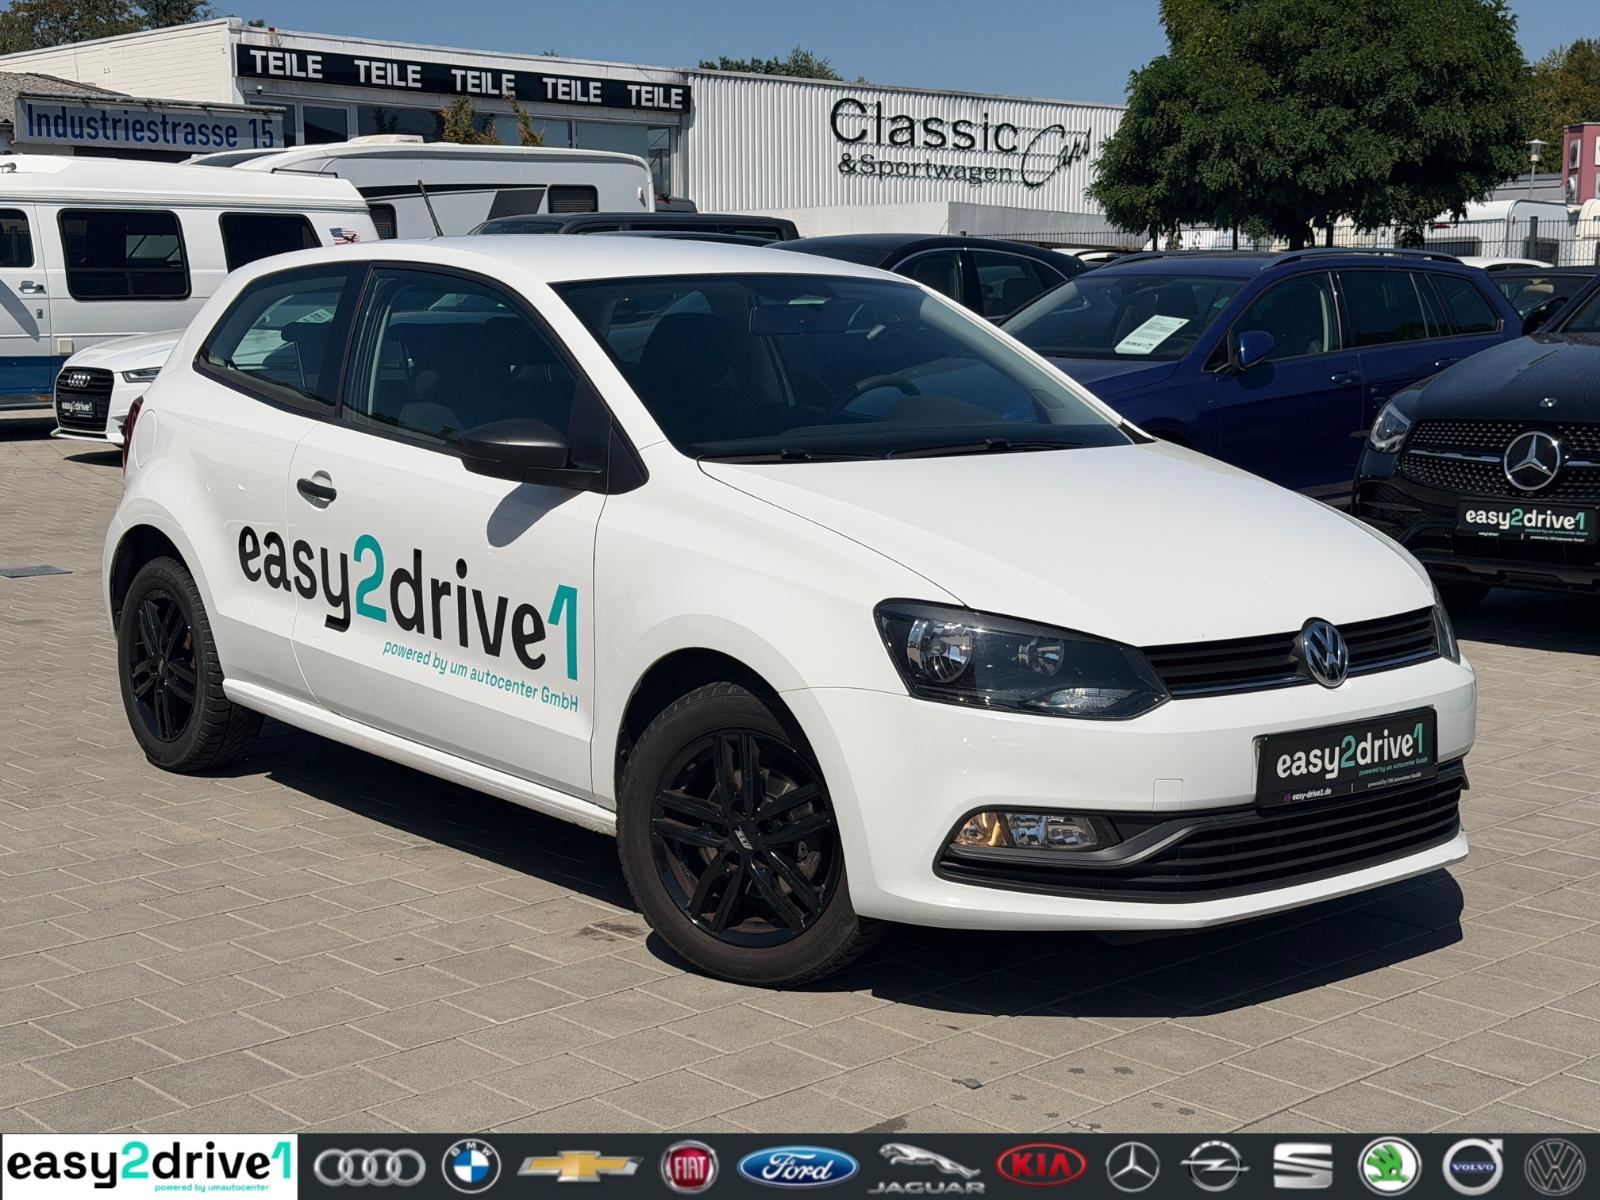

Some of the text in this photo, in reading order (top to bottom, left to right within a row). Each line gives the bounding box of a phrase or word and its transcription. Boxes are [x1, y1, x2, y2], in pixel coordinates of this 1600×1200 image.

[250, 50, 683, 110] TEILE TEILE TEILE TEILE TEILE
[27, 104, 274, 149] Industriestrasse 15
[830, 97, 1018, 152] Classic
[1465, 508, 1586, 530] easy2drive1
[238, 525, 578, 682] easy2drive1
[383, 640, 578, 712] powered by um autocenter GmbH
[1276, 722, 1423, 780] easy2drive1
